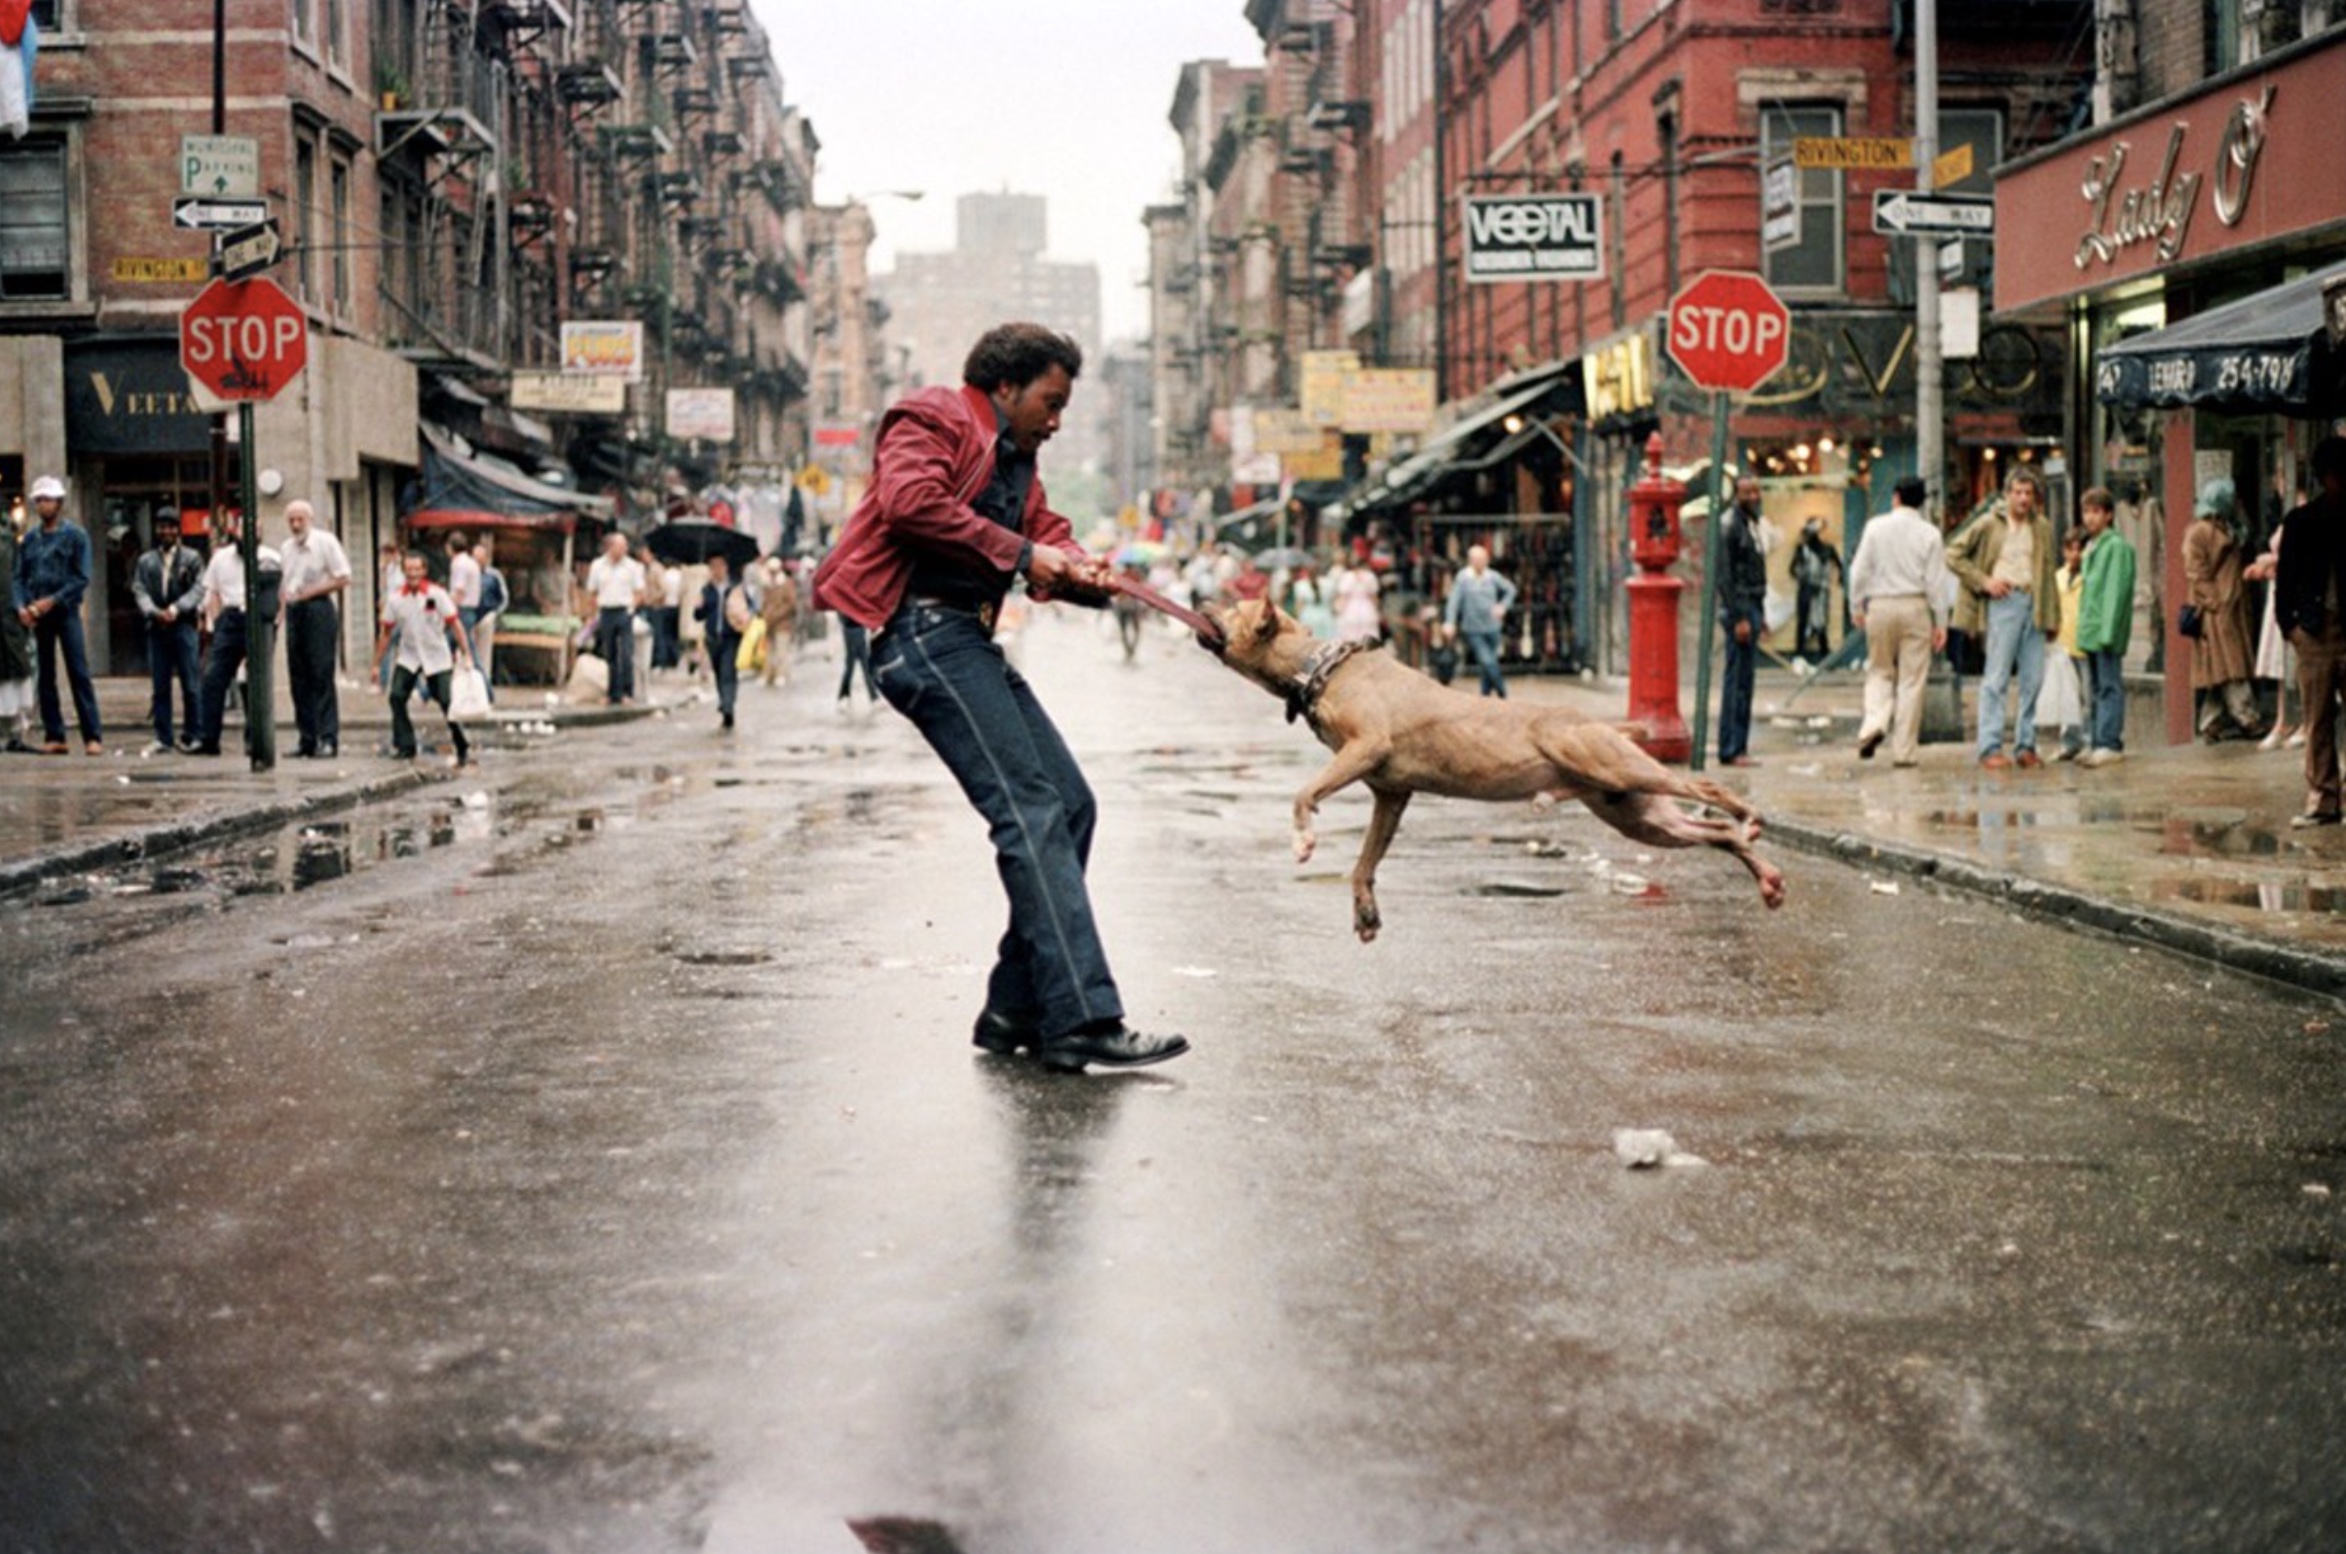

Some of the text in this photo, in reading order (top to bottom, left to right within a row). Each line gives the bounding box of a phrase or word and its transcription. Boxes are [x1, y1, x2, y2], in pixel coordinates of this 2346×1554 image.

[1798, 139, 1898, 164] RIVINGTON
[2073, 120, 2203, 270] Lady
[232, 206, 260, 220] WAY
[1892, 204, 1985, 223] ONE WAY
[114, 258, 188, 278] RIVINGTON
[189, 315, 300, 363] STOP
[1675, 304, 1782, 356] STOP
